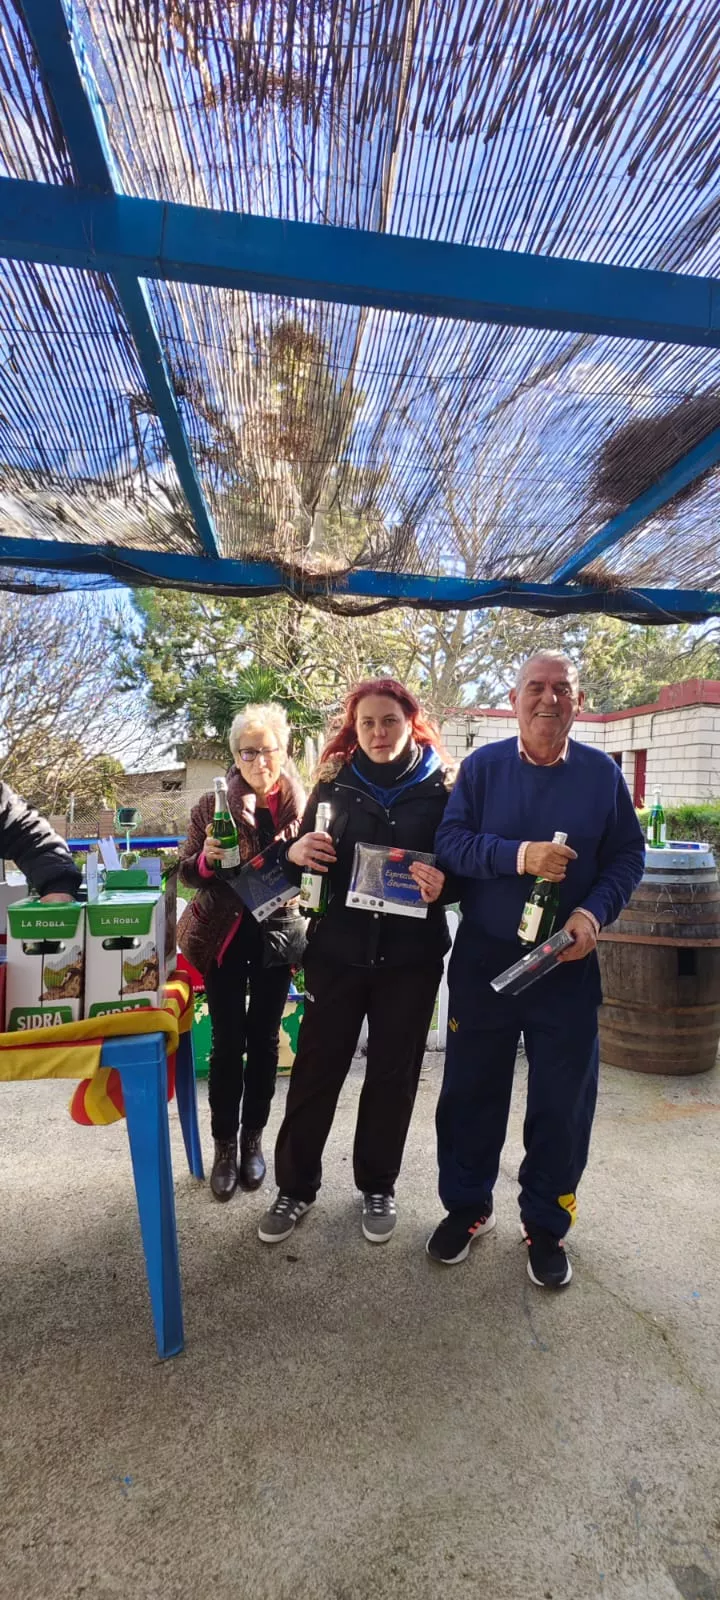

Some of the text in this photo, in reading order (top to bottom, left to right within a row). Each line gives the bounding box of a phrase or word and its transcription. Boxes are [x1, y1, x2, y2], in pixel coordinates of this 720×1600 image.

[21, 920, 65, 928] LA ROBLA
[101, 917, 140, 925] LA ROBLA
[17, 1011, 63, 1030] SIDRA
